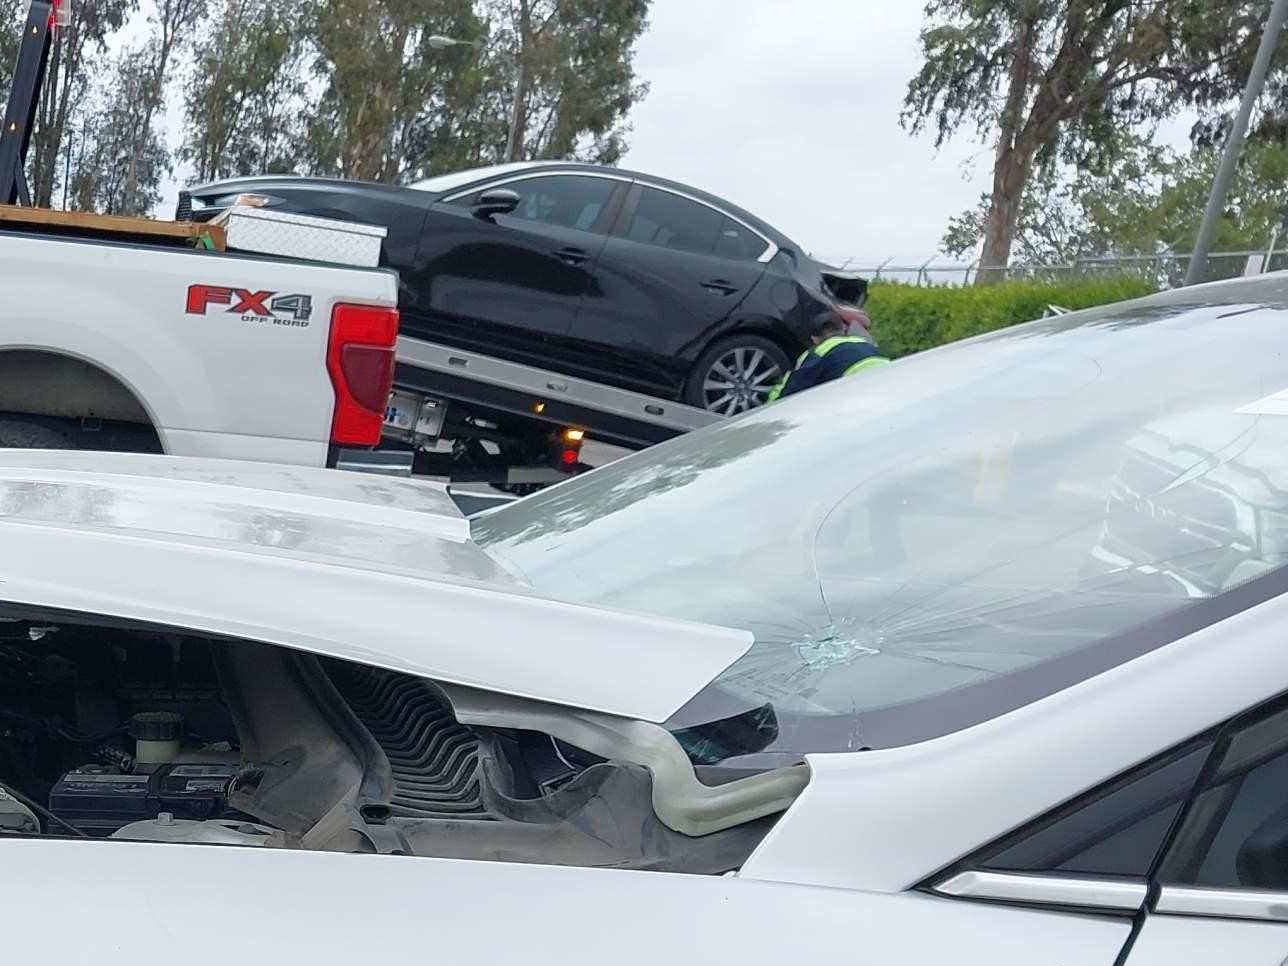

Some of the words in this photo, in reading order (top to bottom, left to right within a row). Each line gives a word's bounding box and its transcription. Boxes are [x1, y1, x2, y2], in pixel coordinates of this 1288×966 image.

[186, 284, 313, 320] FX4
[241, 315, 268, 323] OFF
[273, 318, 309, 328] ROAD
